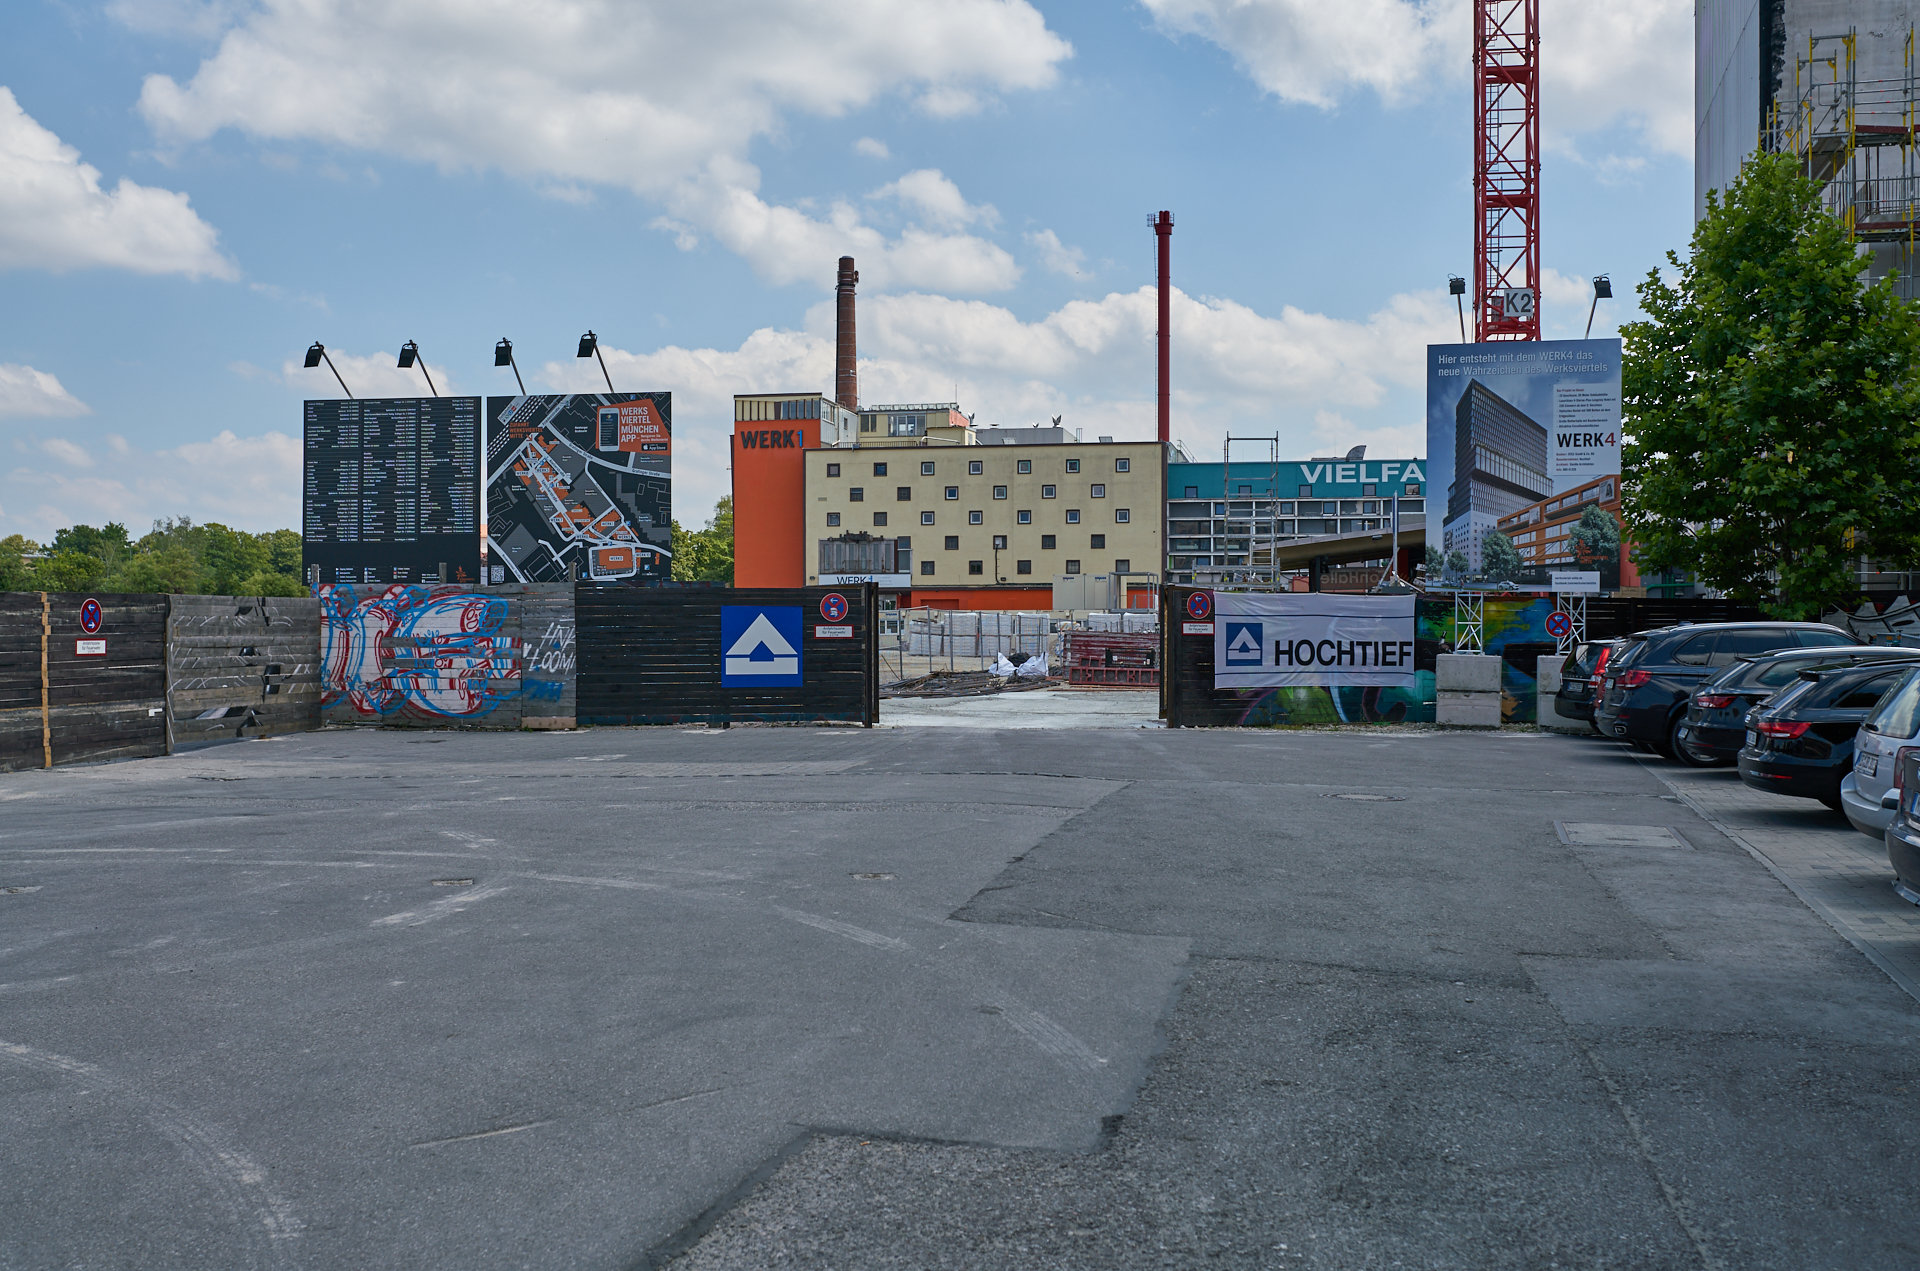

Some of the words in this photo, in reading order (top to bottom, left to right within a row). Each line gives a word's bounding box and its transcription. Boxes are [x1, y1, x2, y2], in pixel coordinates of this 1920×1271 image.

[1506, 292, 1532, 313] K2
[1438, 354, 1457, 364] Hier
[1459, 353, 1497, 364] entsteht
[1499, 352, 1514, 362] mit
[1516, 352, 1536, 362] dem
[1539, 351, 1574, 361] WERK4
[1576, 351, 1593, 360] das
[1438, 368, 1460, 377] neue
[1463, 365, 1522, 376] Wahrzeichen
[1525, 364, 1542, 374] des
[1544, 362, 1608, 373] Werksviertels
[620, 407, 648, 415] WERKS
[620, 415, 651, 424] VIERTEL
[620, 424, 659, 434] MÜNCHEN
[620, 434, 637, 442] APP
[741, 429, 803, 448] WERK1
[1556, 432, 1616, 448] WERK4
[1300, 462, 1426, 484] VIELFA
[1274, 639, 1413, 667] HOCHTIEF
